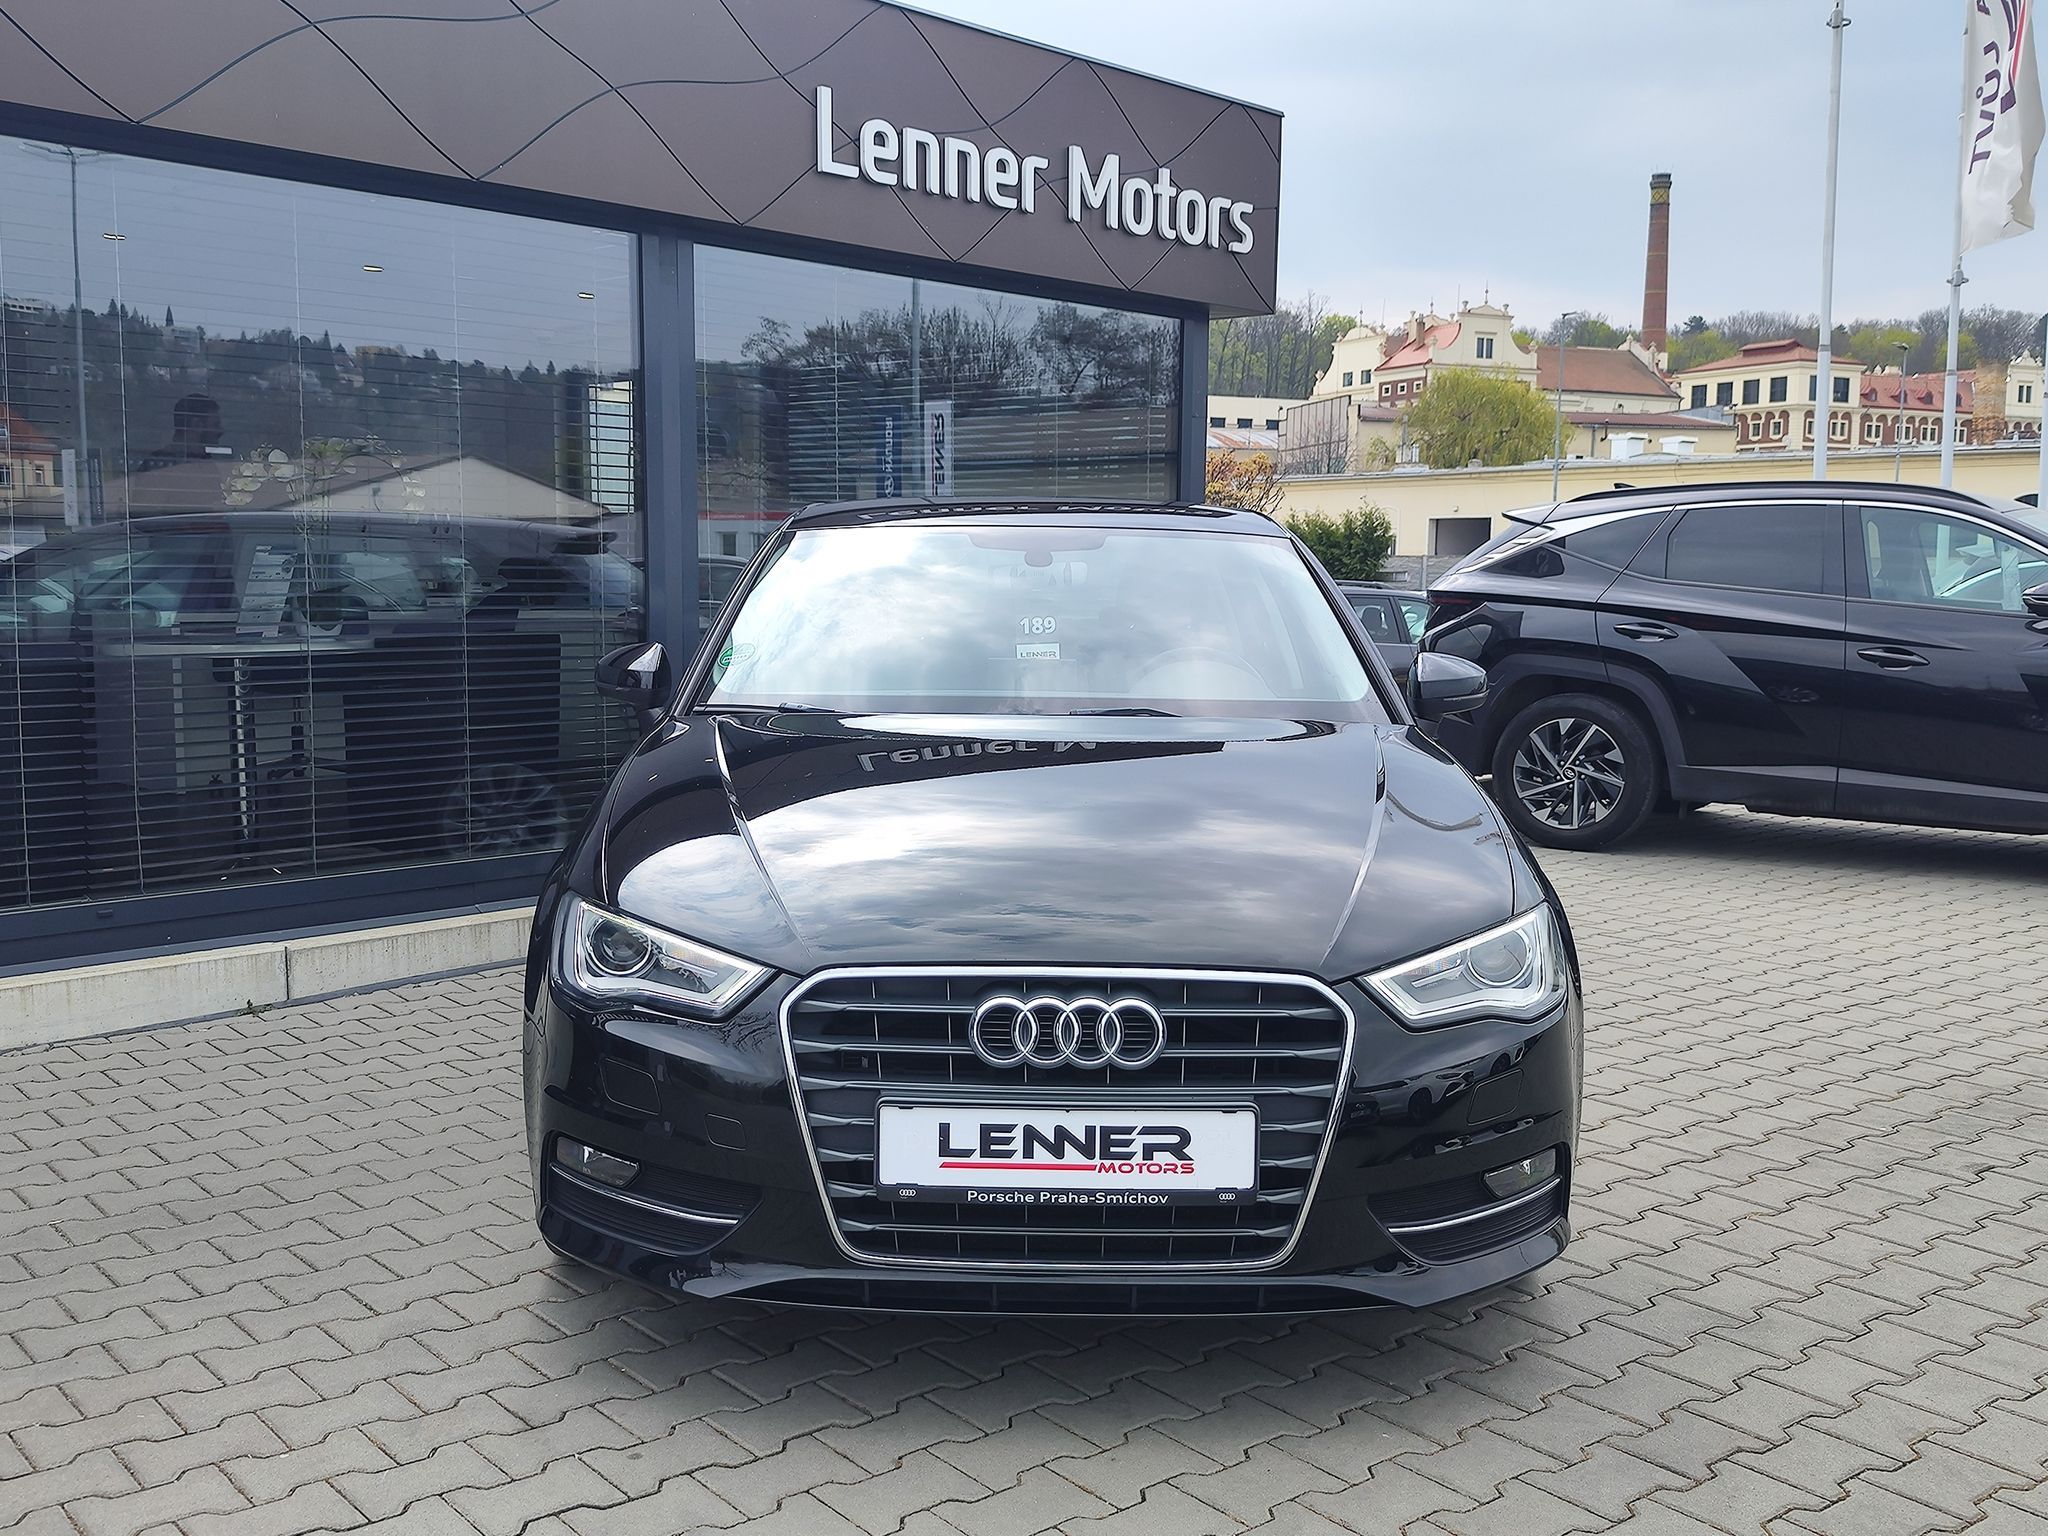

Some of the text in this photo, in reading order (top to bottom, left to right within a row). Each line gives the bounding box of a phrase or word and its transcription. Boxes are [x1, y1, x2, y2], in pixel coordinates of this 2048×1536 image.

[816, 85, 1255, 254] Lenner Motors
[1020, 616, 1056, 634] 189
[938, 1122, 1194, 1161] LENNER
[1097, 1162, 1195, 1174] MOTORS
[967, 1190, 1169, 1205] Porsche Praha-Smíchov
